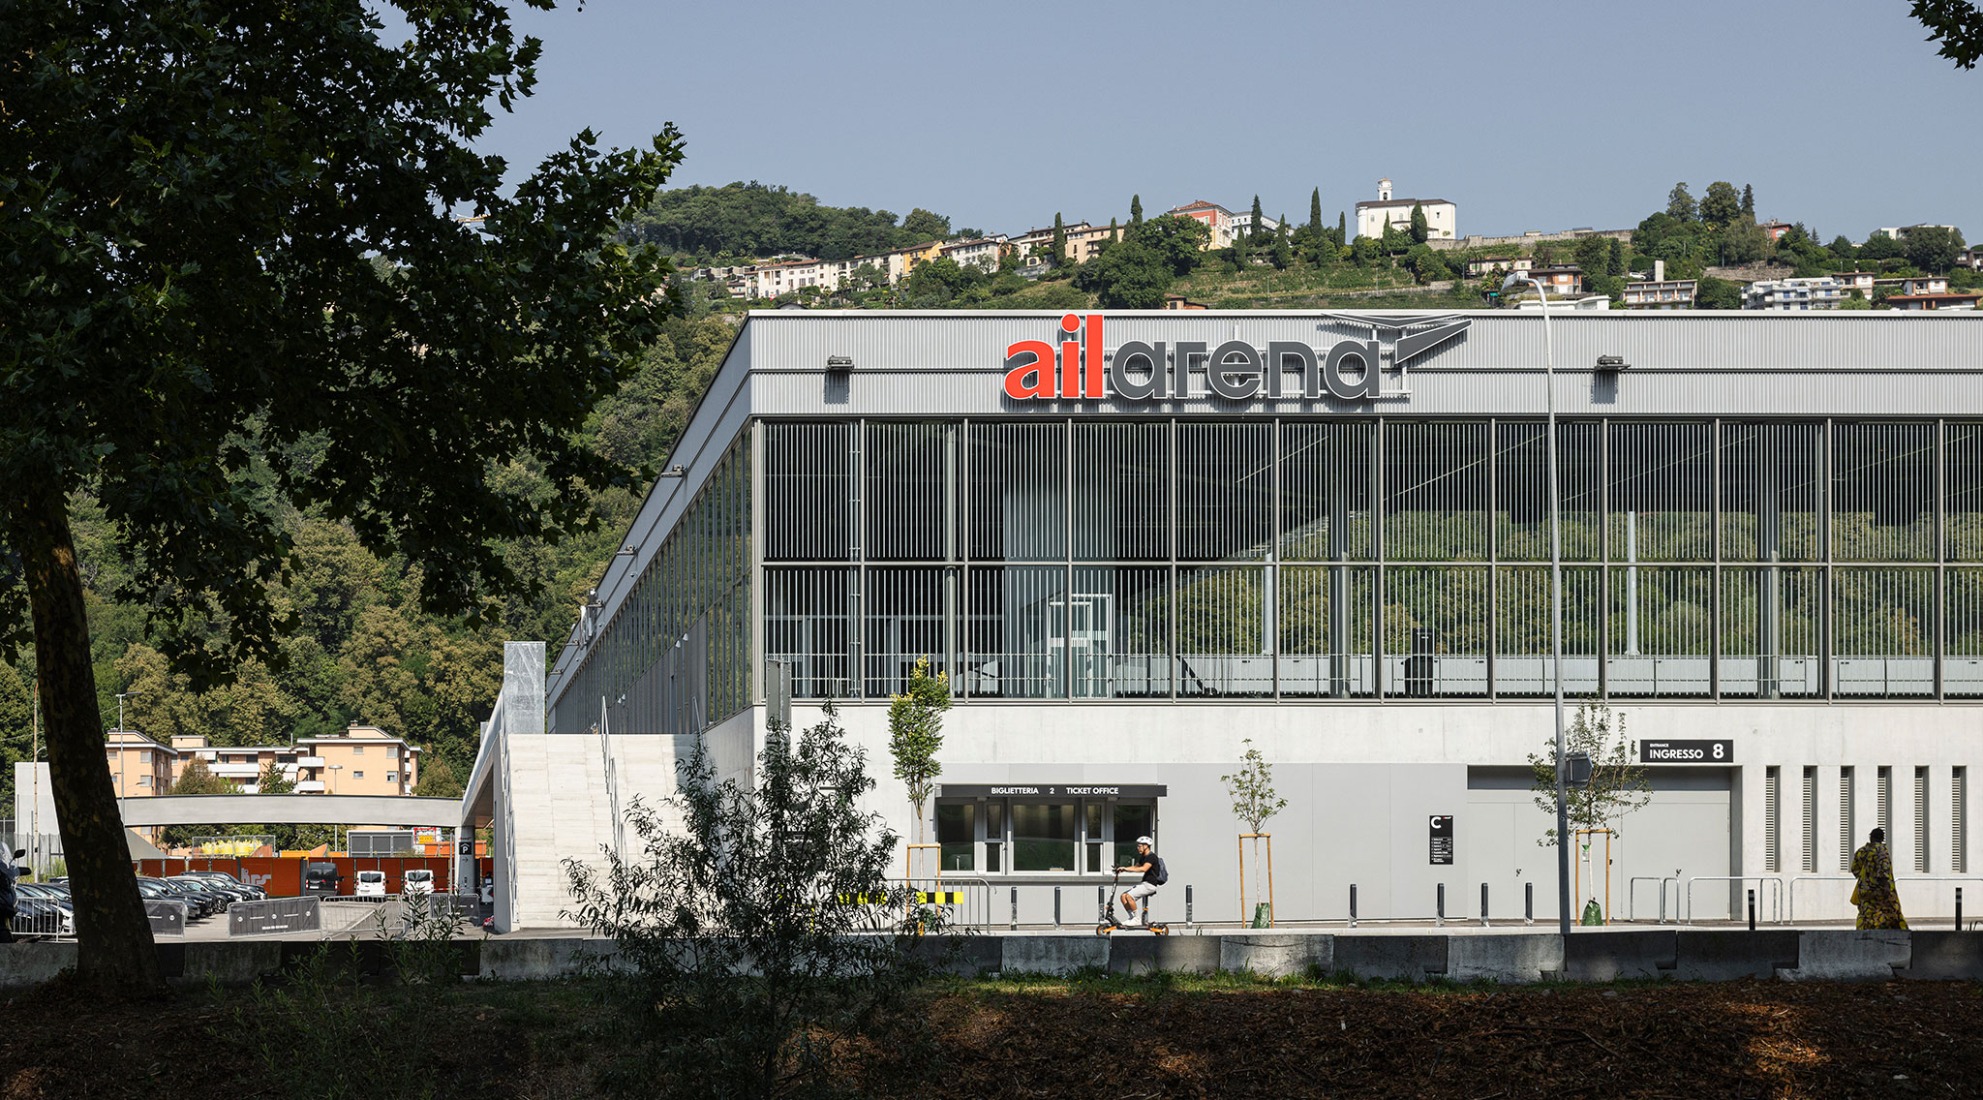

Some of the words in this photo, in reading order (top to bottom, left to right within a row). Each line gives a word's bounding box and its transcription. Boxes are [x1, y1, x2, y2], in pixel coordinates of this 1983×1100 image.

[1649, 749, 1704, 759] INGRESSO
[1712, 743, 1725, 759] 8
[991, 787, 1039, 795] BIGLIETTERIA
[1049, 787, 1055, 795] 2
[1066, 787, 1091, 795] TICKET
[1092, 787, 1119, 795] OFFICE
[1430, 816, 1442, 829] C
